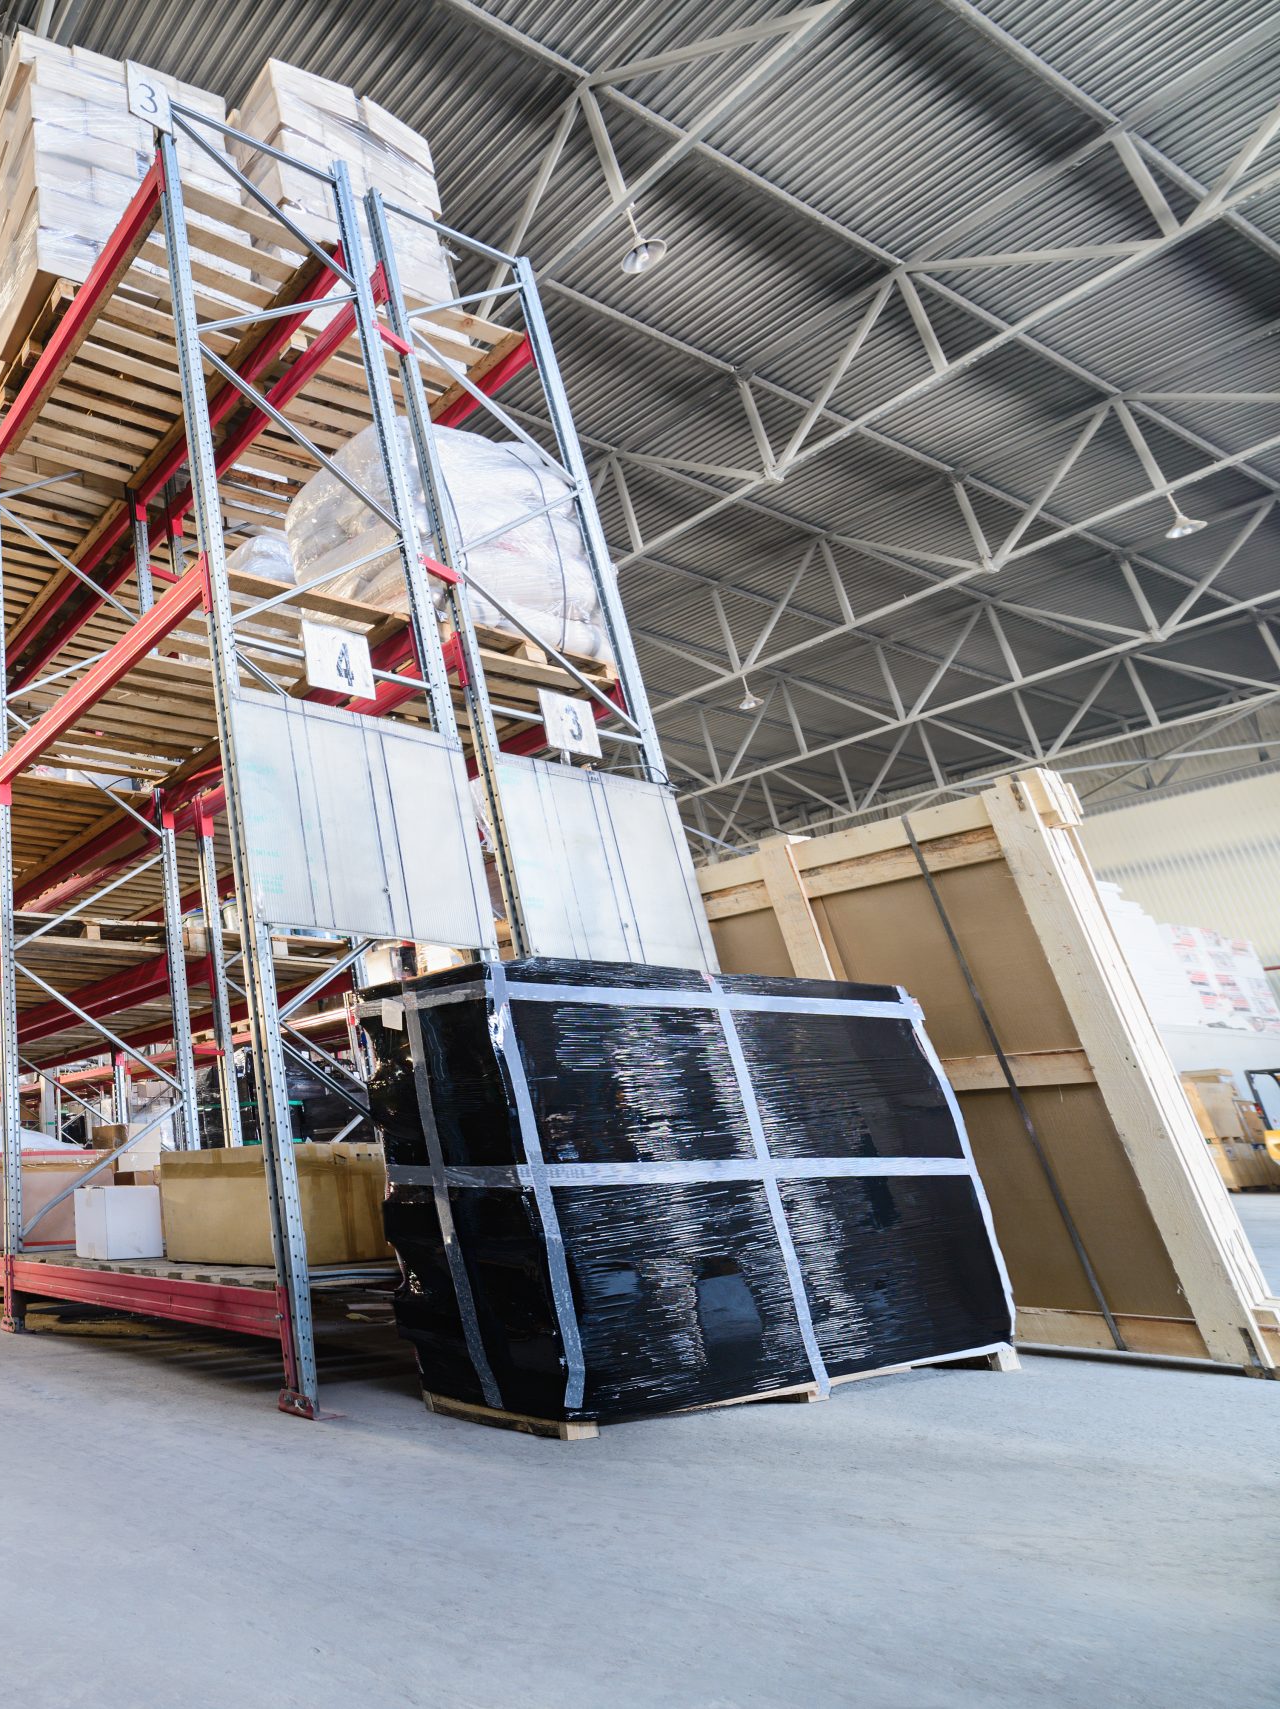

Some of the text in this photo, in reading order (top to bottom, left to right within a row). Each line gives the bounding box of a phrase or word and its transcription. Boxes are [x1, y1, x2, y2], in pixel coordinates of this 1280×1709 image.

[139, 83, 157, 113] 3
[336, 643, 354, 686] 4
[565, 705, 582, 741] 3
